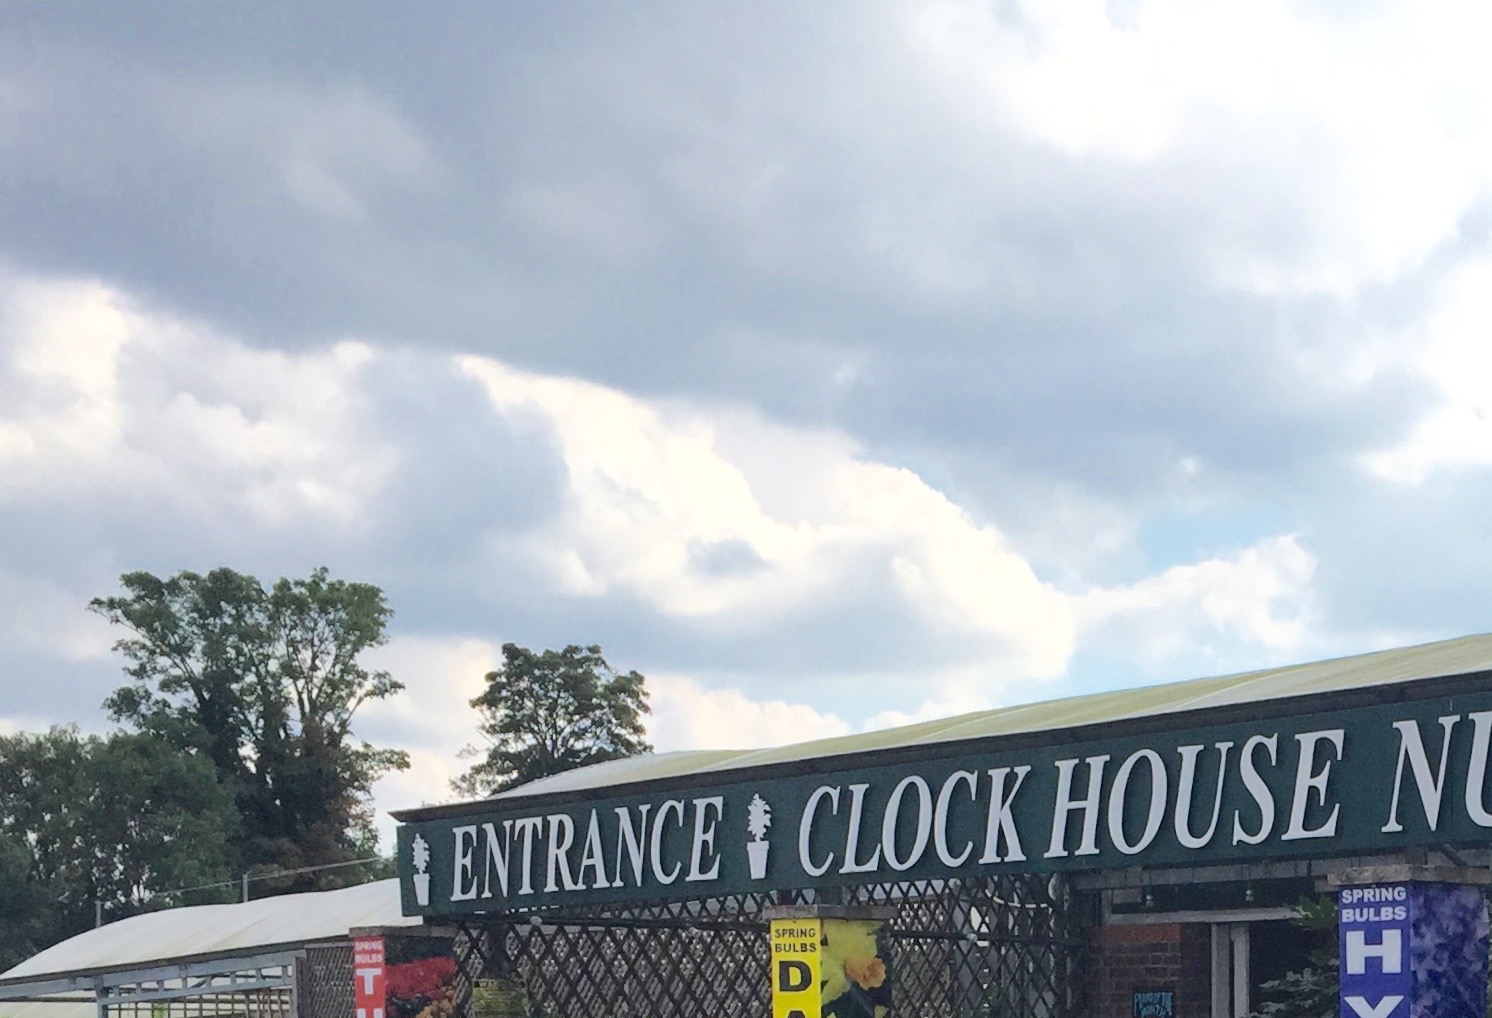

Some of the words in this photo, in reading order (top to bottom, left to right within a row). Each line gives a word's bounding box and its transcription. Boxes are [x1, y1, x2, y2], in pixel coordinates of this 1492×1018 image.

[450, 796, 724, 902] ENTRANCE
[799, 765, 1031, 876] CLOCK
[1043, 728, 1346, 859] HOUSE
[1341, 886, 1407, 904] SPRING
[1341, 905, 1407, 923] BULBS
[775, 927, 816, 939] SPRING
[775, 942, 817, 954] BULBS
